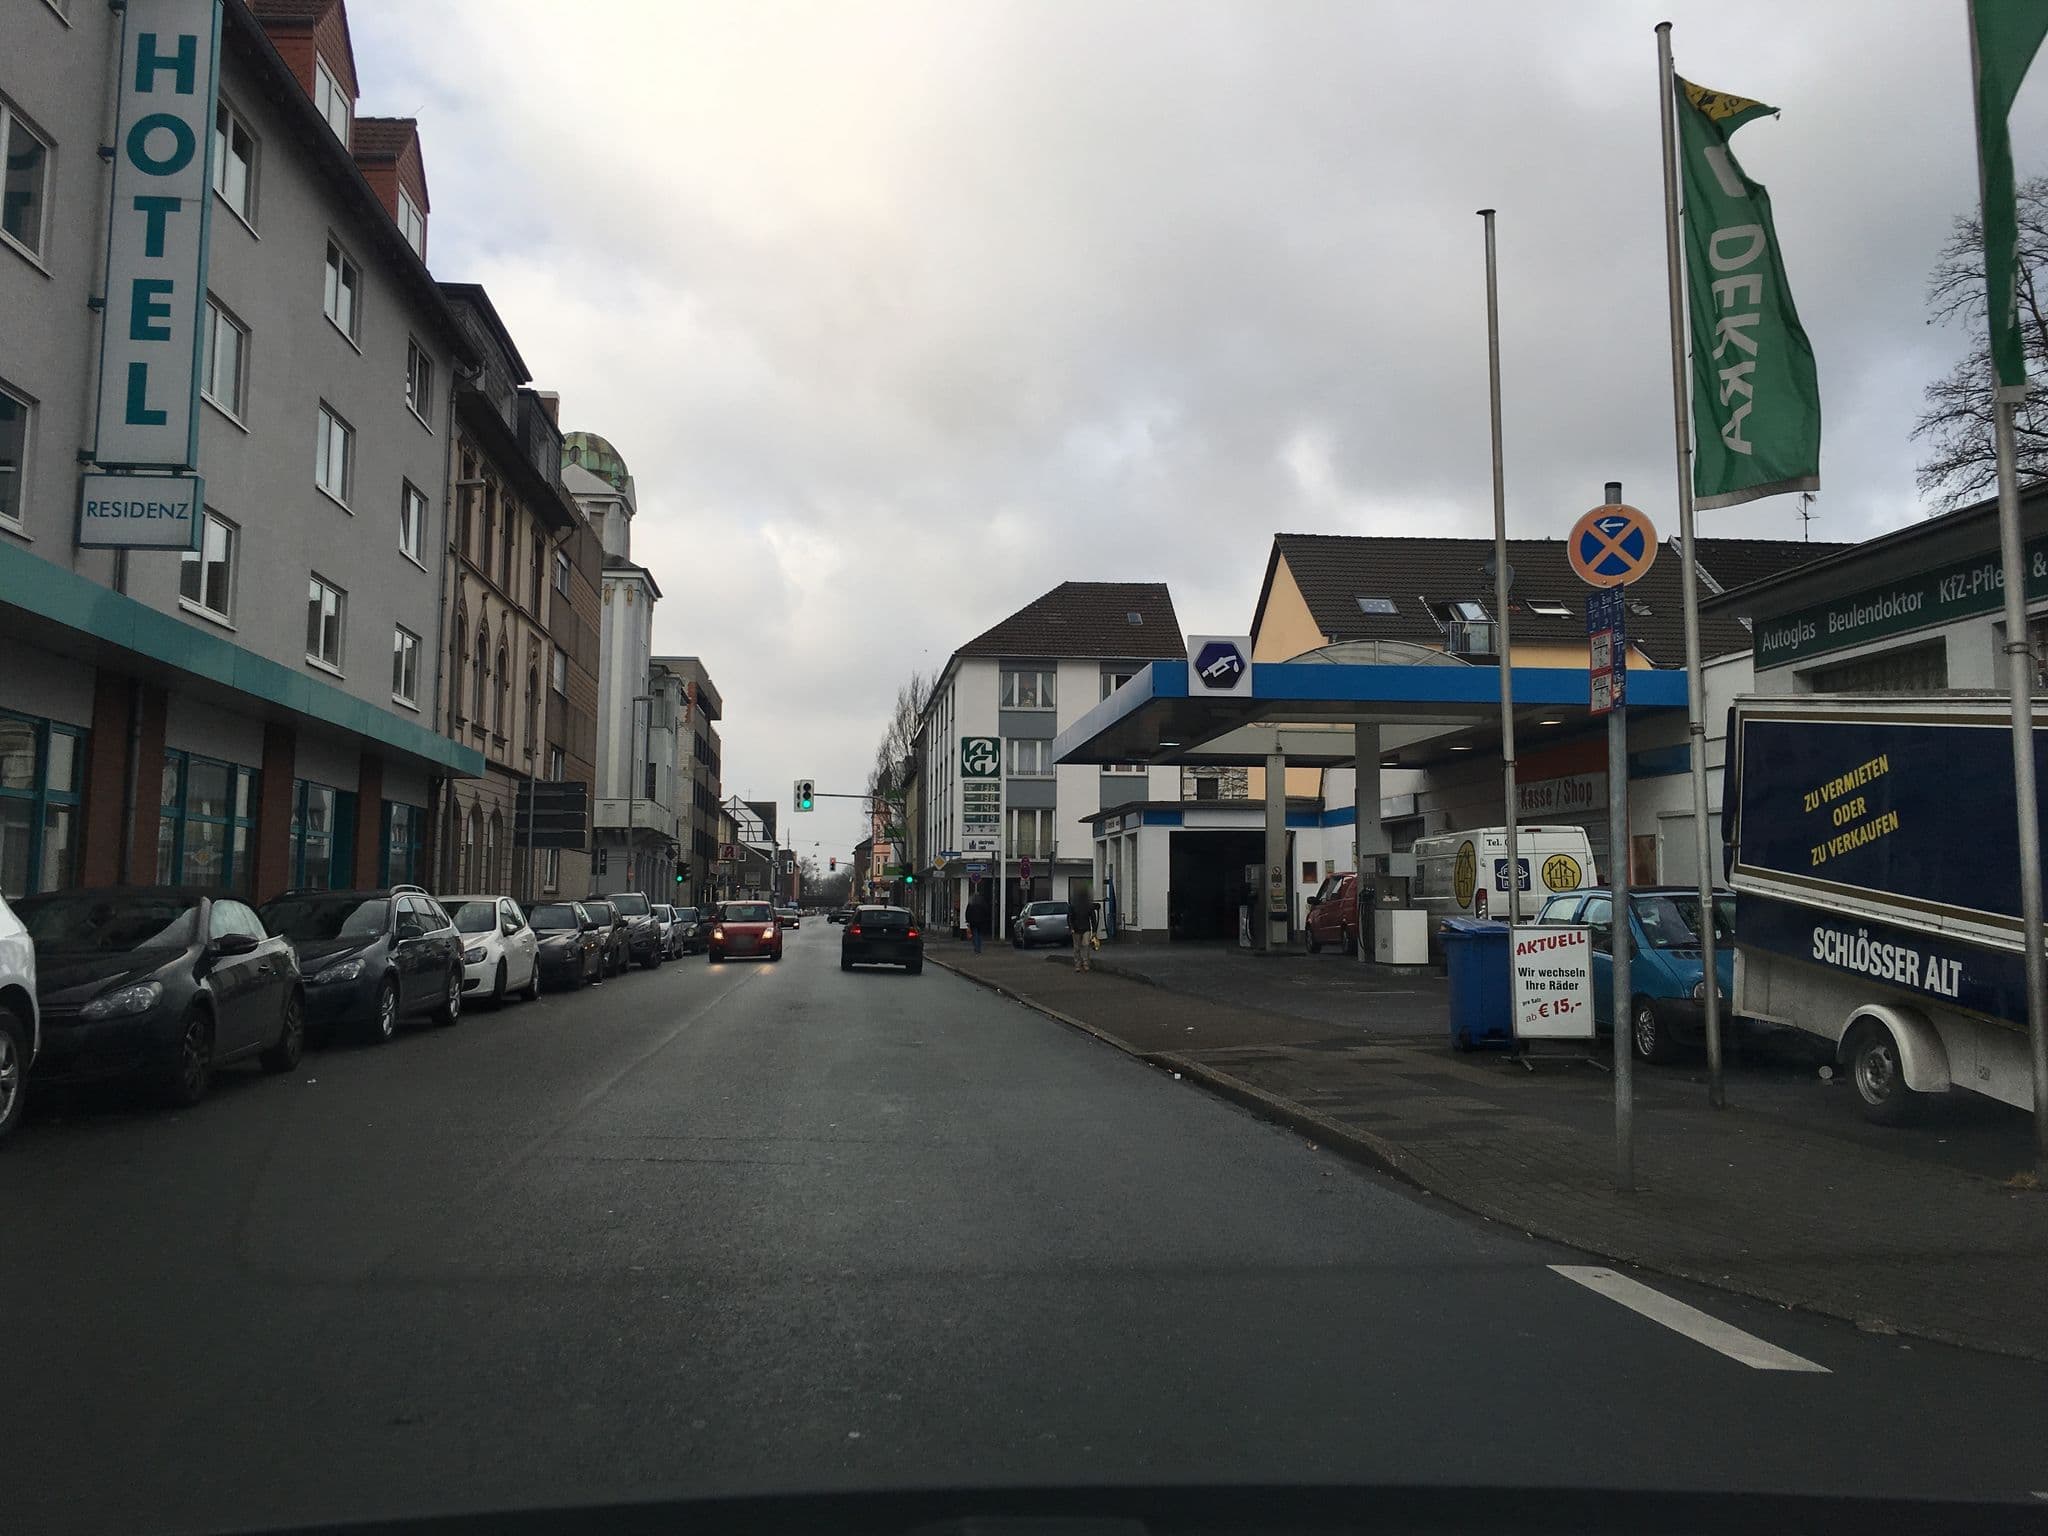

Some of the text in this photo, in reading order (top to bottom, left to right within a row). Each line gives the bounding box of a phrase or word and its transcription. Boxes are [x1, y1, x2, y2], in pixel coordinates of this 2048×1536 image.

[126, 33, 197, 425] HOTEL
[87, 501, 189, 519] RESIDENZ
[1762, 552, 2048, 652] Autoglas Beulendoktor KfZ-Pfle &
[1520, 786, 1552, 810] Kasse
[1563, 778, 1593, 807] Shop
[1804, 754, 1889, 813] ZU VERMIETEN
[1833, 797, 1867, 827] ODER
[1486, 838, 1503, 847] Tel.
[1811, 811, 1900, 866] ZU VERKAUFEN
[1516, 931, 1585, 955] AKTUELL
[1518, 967, 1586, 977] Wir wechseln
[1813, 927, 1963, 997] SCHLÖSSER ALT
[1525, 980, 1579, 991] Ihre Räder
[1526, 998, 1582, 1023] ab € 15,-
